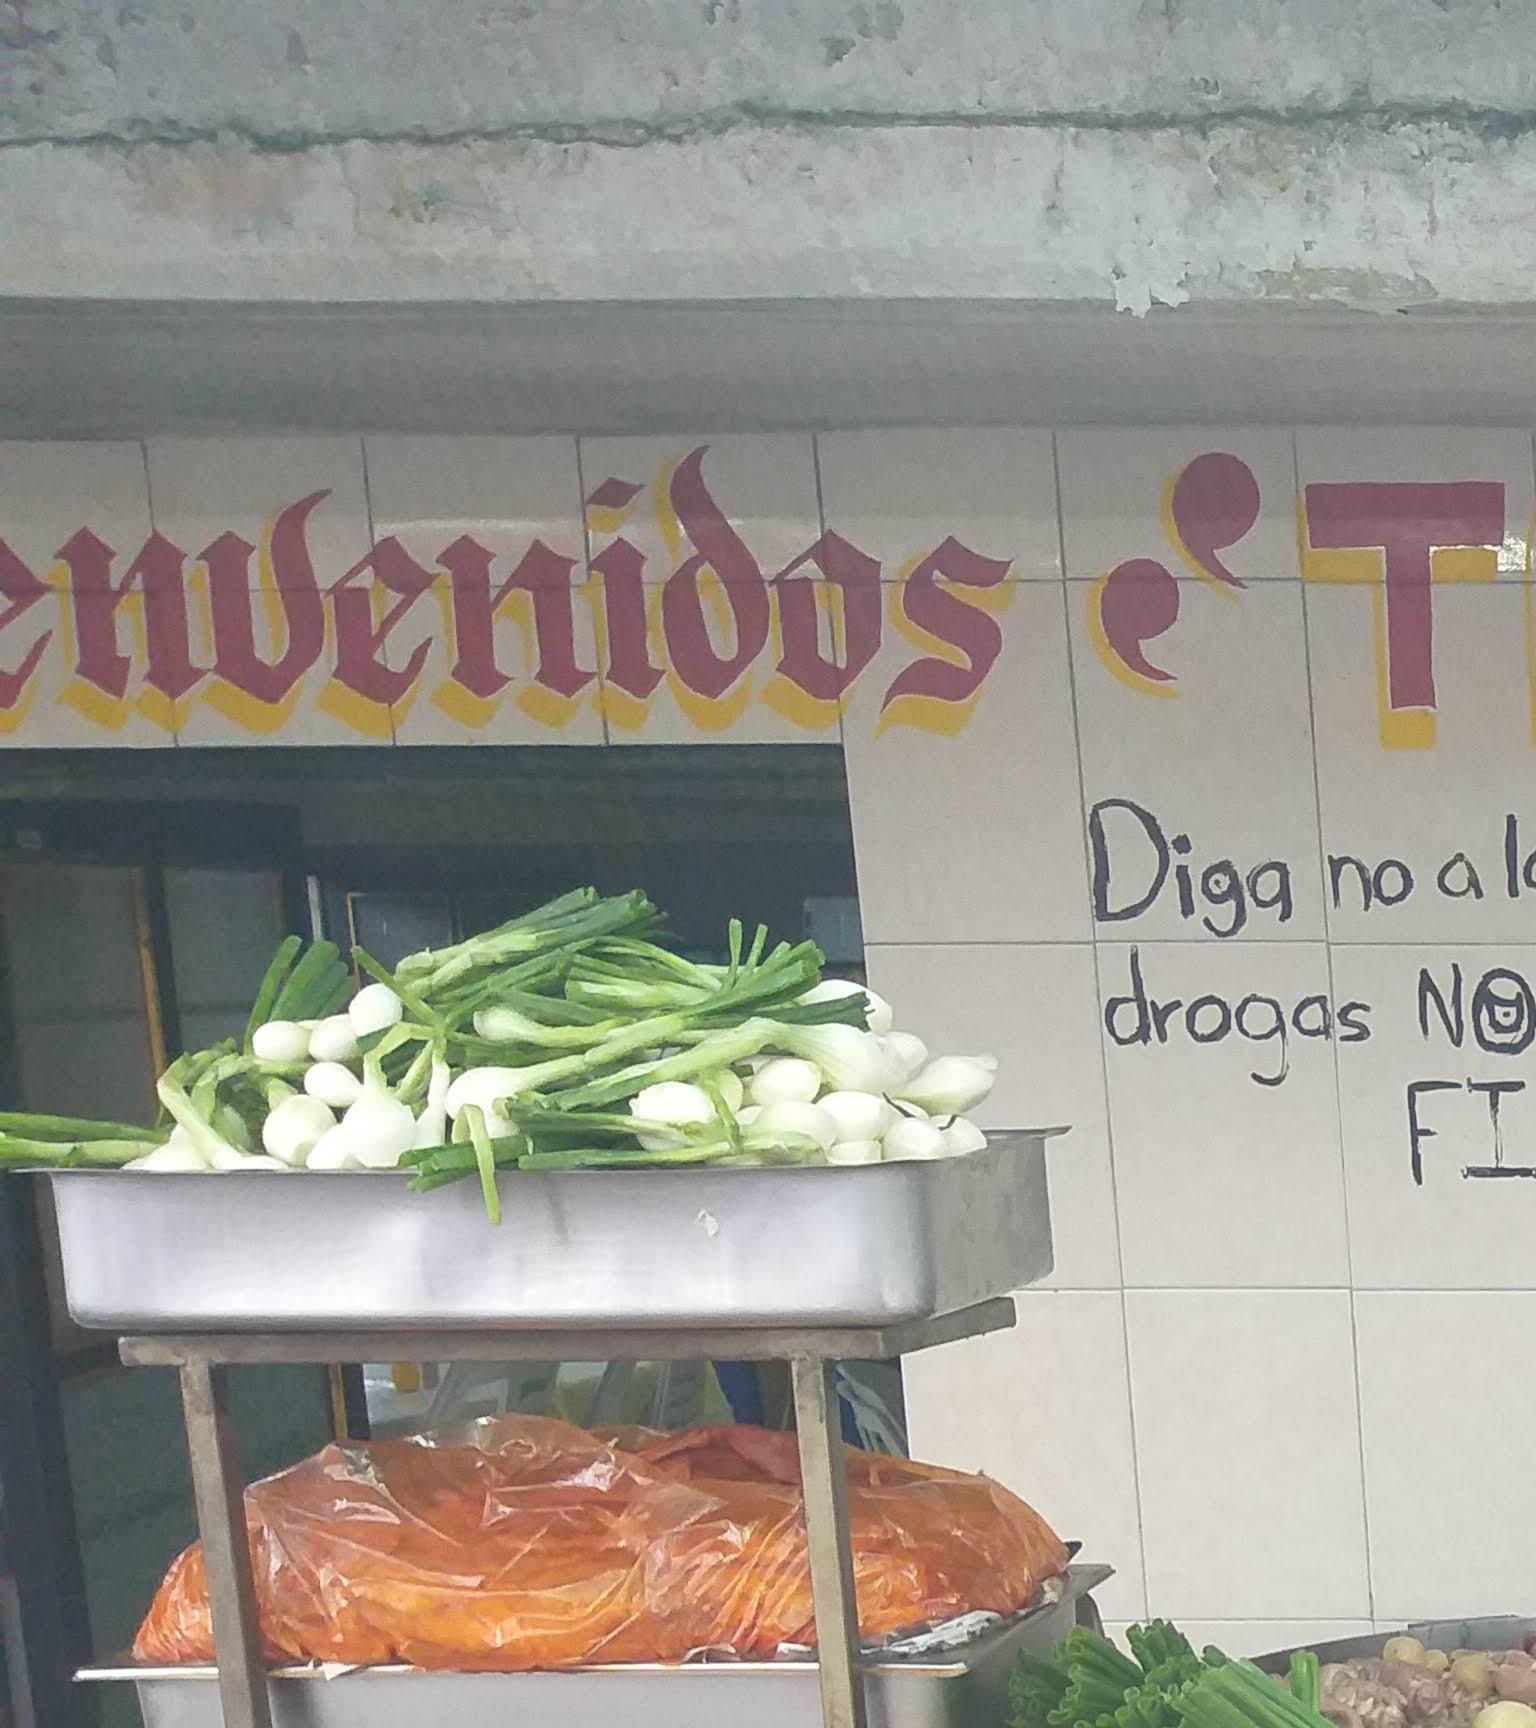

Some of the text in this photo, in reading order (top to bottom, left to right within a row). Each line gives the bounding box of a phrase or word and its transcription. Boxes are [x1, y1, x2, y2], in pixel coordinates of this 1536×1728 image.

[1089, 799, 1292, 937] Diga
[1328, 854, 1414, 911] no
[1437, 852, 1483, 899] a
[1105, 946, 1372, 1086] drogas
[1418, 963, 1536, 1054] NO
